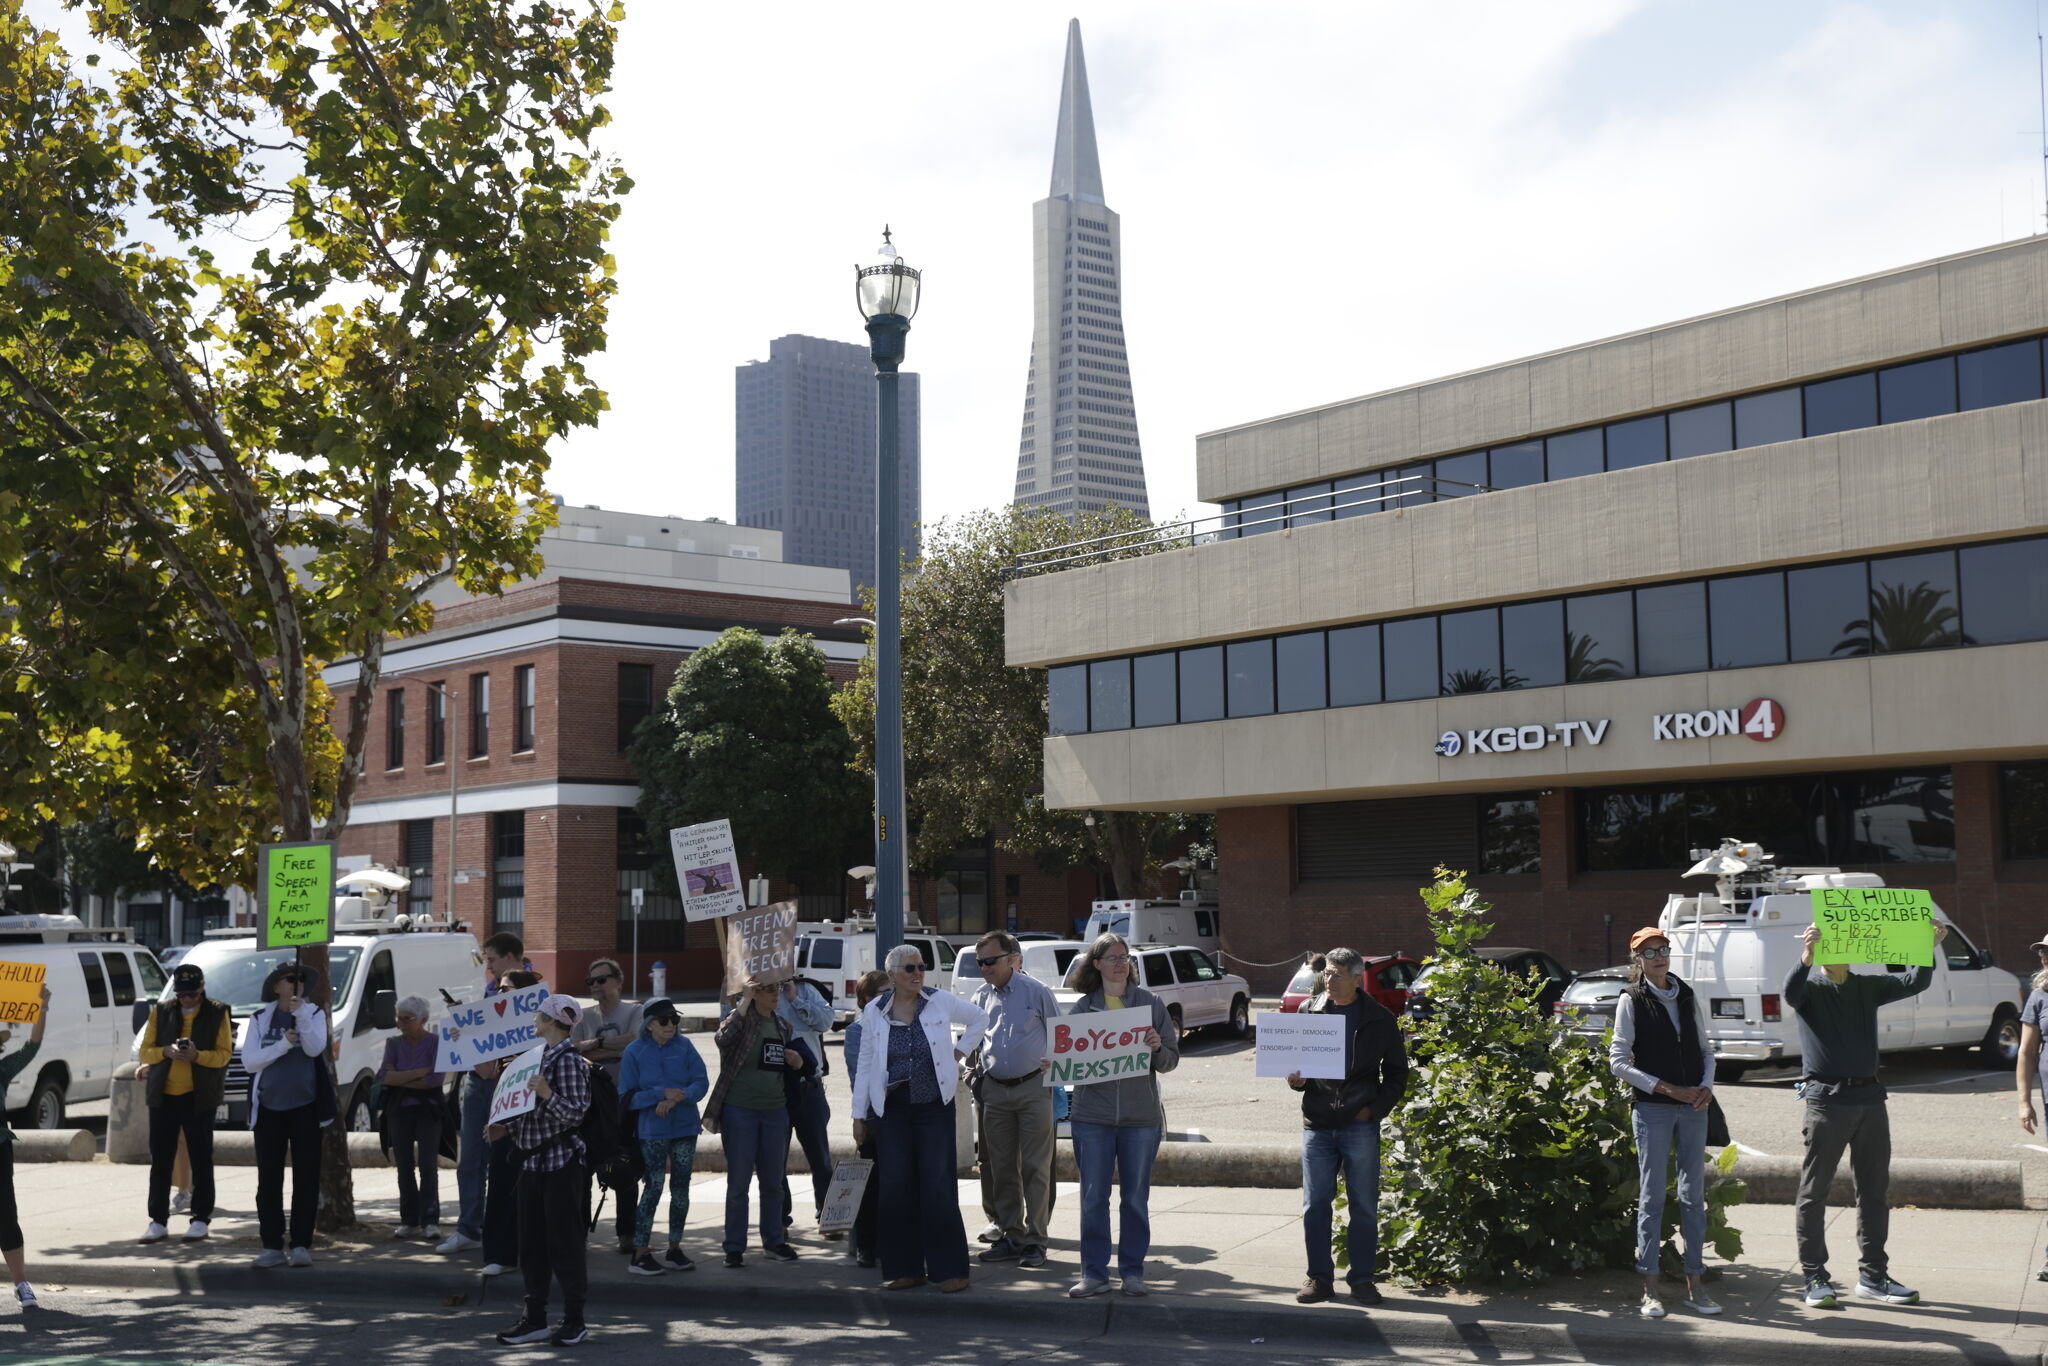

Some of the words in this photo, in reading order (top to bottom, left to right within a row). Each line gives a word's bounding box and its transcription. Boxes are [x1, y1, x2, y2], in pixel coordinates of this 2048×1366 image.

[1653, 708, 1740, 741] KRON
[1745, 700, 1775, 738] 4
[1468, 720, 1609, 753] KGO-TV
[283, 854, 316, 870] FREE
[684, 850, 711, 862] HITLER
[275, 872, 318, 888] SPEECH
[287, 889, 297, 897] IS
[299, 889, 309, 898] A
[1862, 889, 1915, 905] HULU
[279, 900, 311, 912] FIRST
[272, 916, 326, 929] AMENDMENT
[1823, 907, 1933, 922] SUBSCRIBER
[733, 909, 795, 937] DEFEND
[1830, 923, 1882, 939] 9-18-25
[741, 930, 782, 953] FREE
[1821, 939, 1855, 954] RIP
[1857, 939, 1889, 954] FREE
[733, 950, 789, 978] SPEECH
[0, 1001, 40, 1021] IBER
[453, 1009, 485, 1028] WE
[473, 1025, 537, 1054] WORKE
[1302, 1045, 1341, 1053] DICTATORSHIP
[1050, 1052, 1149, 1082] NEXSTAR
